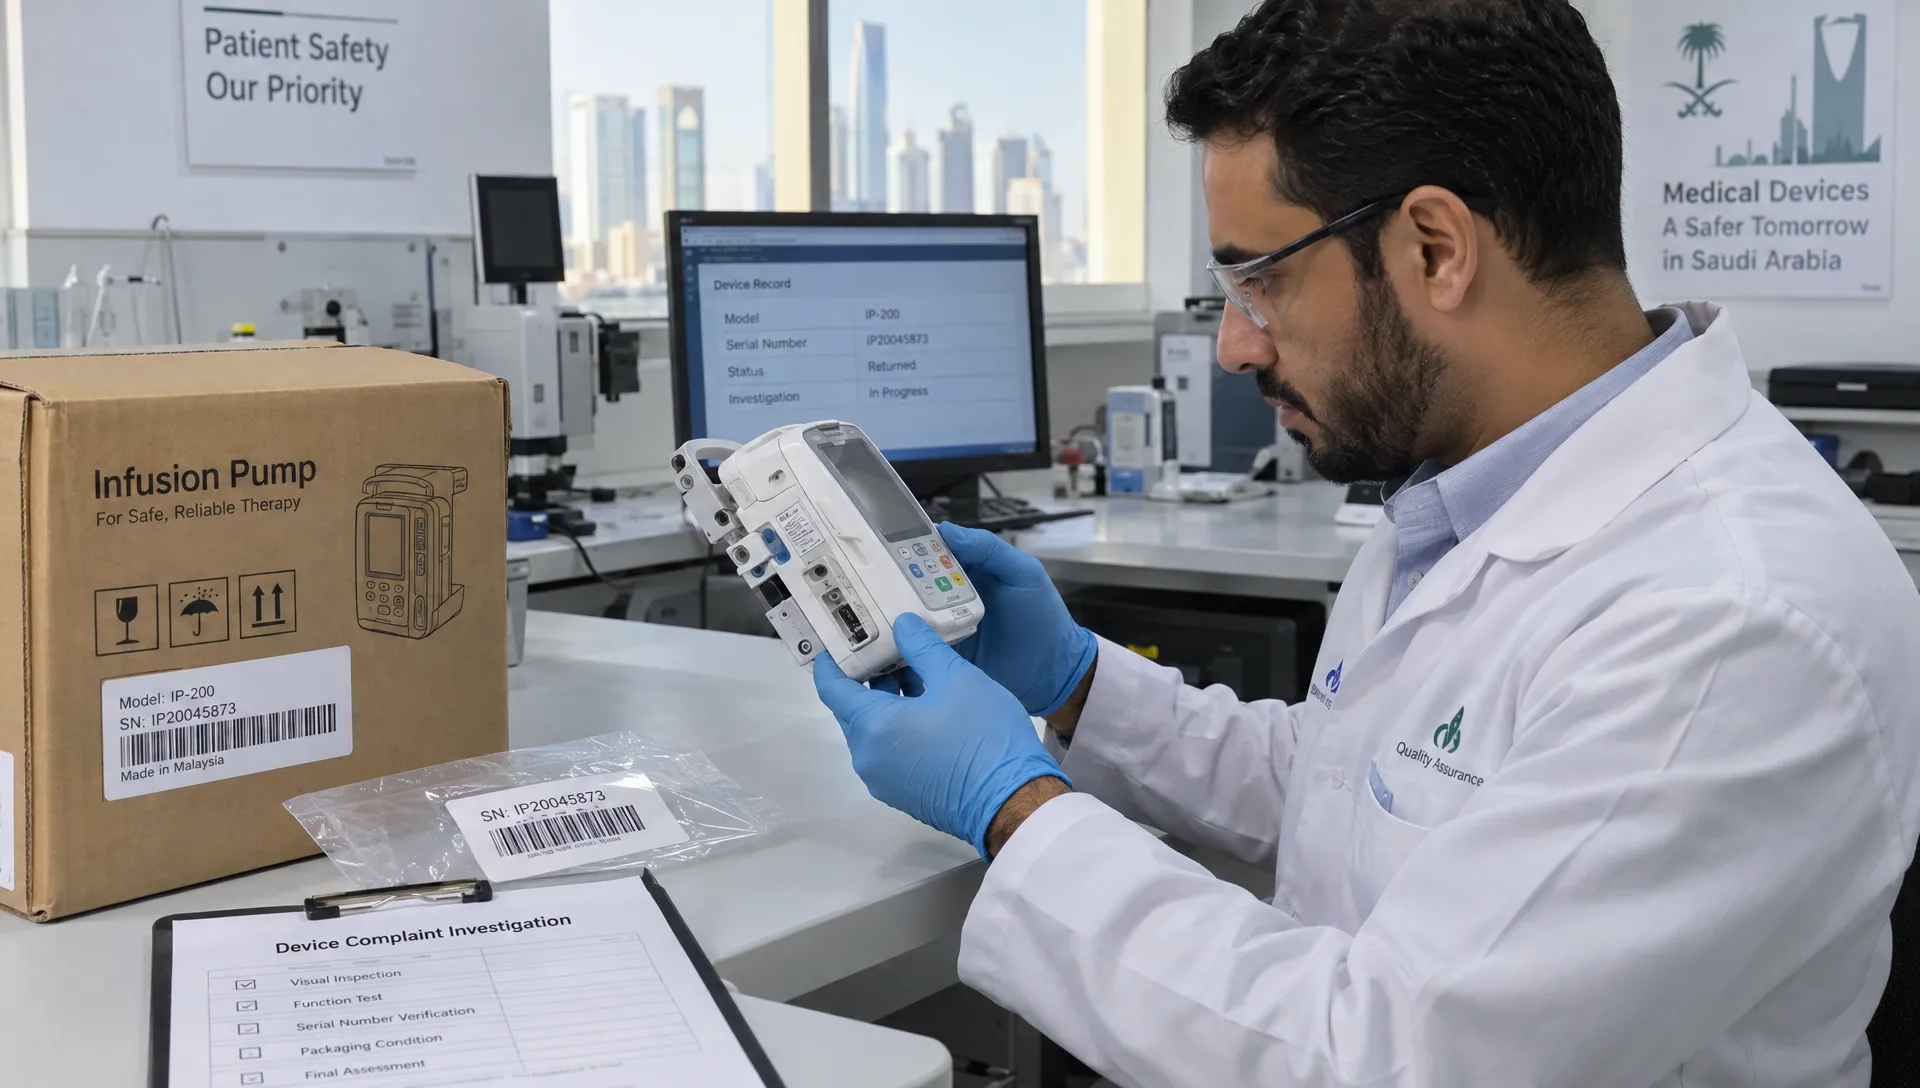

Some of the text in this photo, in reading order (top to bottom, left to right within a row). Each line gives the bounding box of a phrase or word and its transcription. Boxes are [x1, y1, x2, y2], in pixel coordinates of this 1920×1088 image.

[205, 27, 389, 71] Patient Safety
[206, 71, 363, 113] Our Priority
[1663, 178, 1870, 204] Medical Devices
[1662, 215, 1870, 238] A Safer Tomorrow
[1662, 249, 1842, 271] in Saudi Arabia
[714, 278, 791, 291] Device Record
[725, 312, 760, 325] Model
[865, 308, 900, 320] IP-200
[726, 337, 807, 351] Serial Number
[866, 333, 929, 346] IP20045873
[727, 365, 764, 378] Status
[868, 360, 916, 373] Returned
[729, 391, 800, 407] Investigation
[869, 386, 929, 400] In Progress
[95, 459, 317, 499] Infusion Pump
[96, 497, 301, 526] For Safe, Reliable Therapy
[119, 685, 215, 710] Model: IP-200
[120, 702, 237, 731] SN: IP20045873
[121, 755, 224, 782] Made in Malaysia
[1396, 741, 1485, 787] Quality Assurance
[480, 790, 606, 823] SN: IP20045873
[276, 913, 572, 954] Device Complaint Investigation
[290, 969, 402, 987] Visual Inspection
[294, 993, 383, 1009] Function Test
[296, 1006, 476, 1032] Serial Number Verification
[300, 1033, 443, 1056] Packaging Condition
[304, 1059, 426, 1080] Final Assessment
